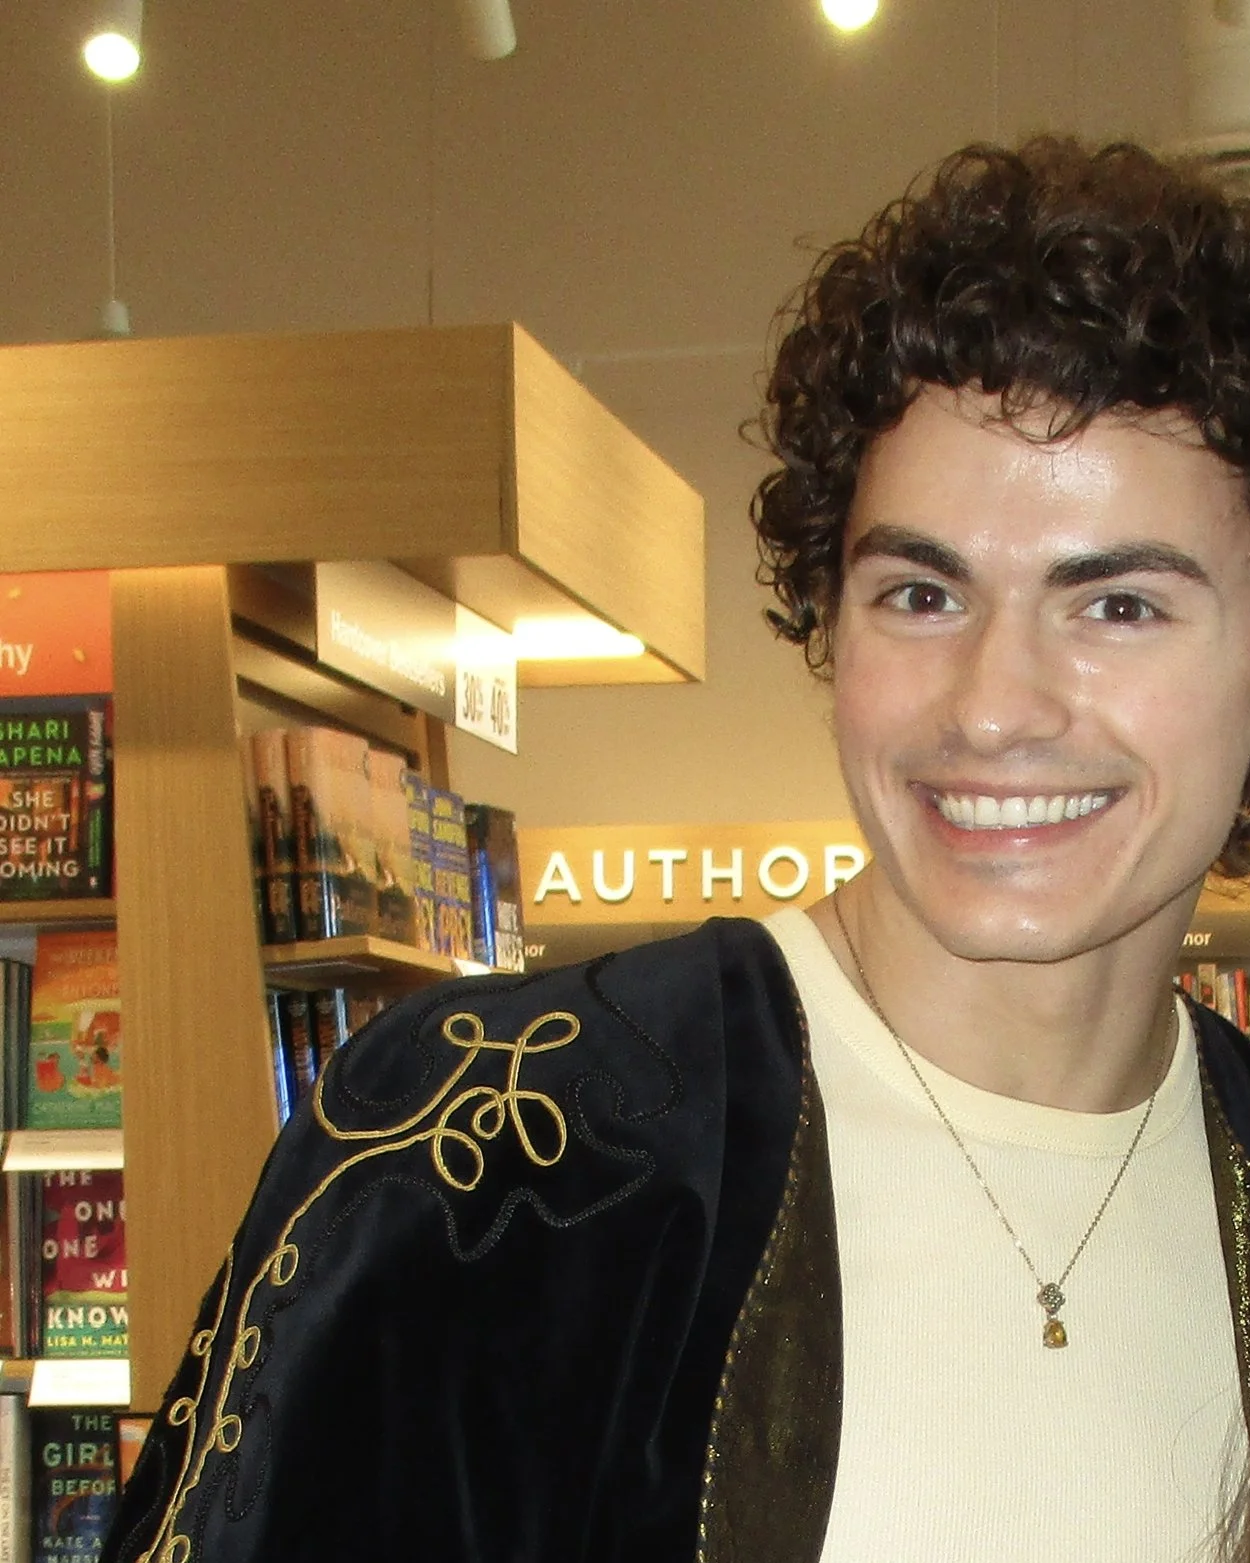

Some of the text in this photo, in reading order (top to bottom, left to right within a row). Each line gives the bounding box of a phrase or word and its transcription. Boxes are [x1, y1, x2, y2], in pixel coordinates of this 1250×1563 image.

[12, 791, 54, 808] SHE
[47, 837, 67, 854] IT
[43, 1171, 93, 1187] THE
[43, 1236, 98, 1259] ONE
[71, 1414, 113, 1431] THE
